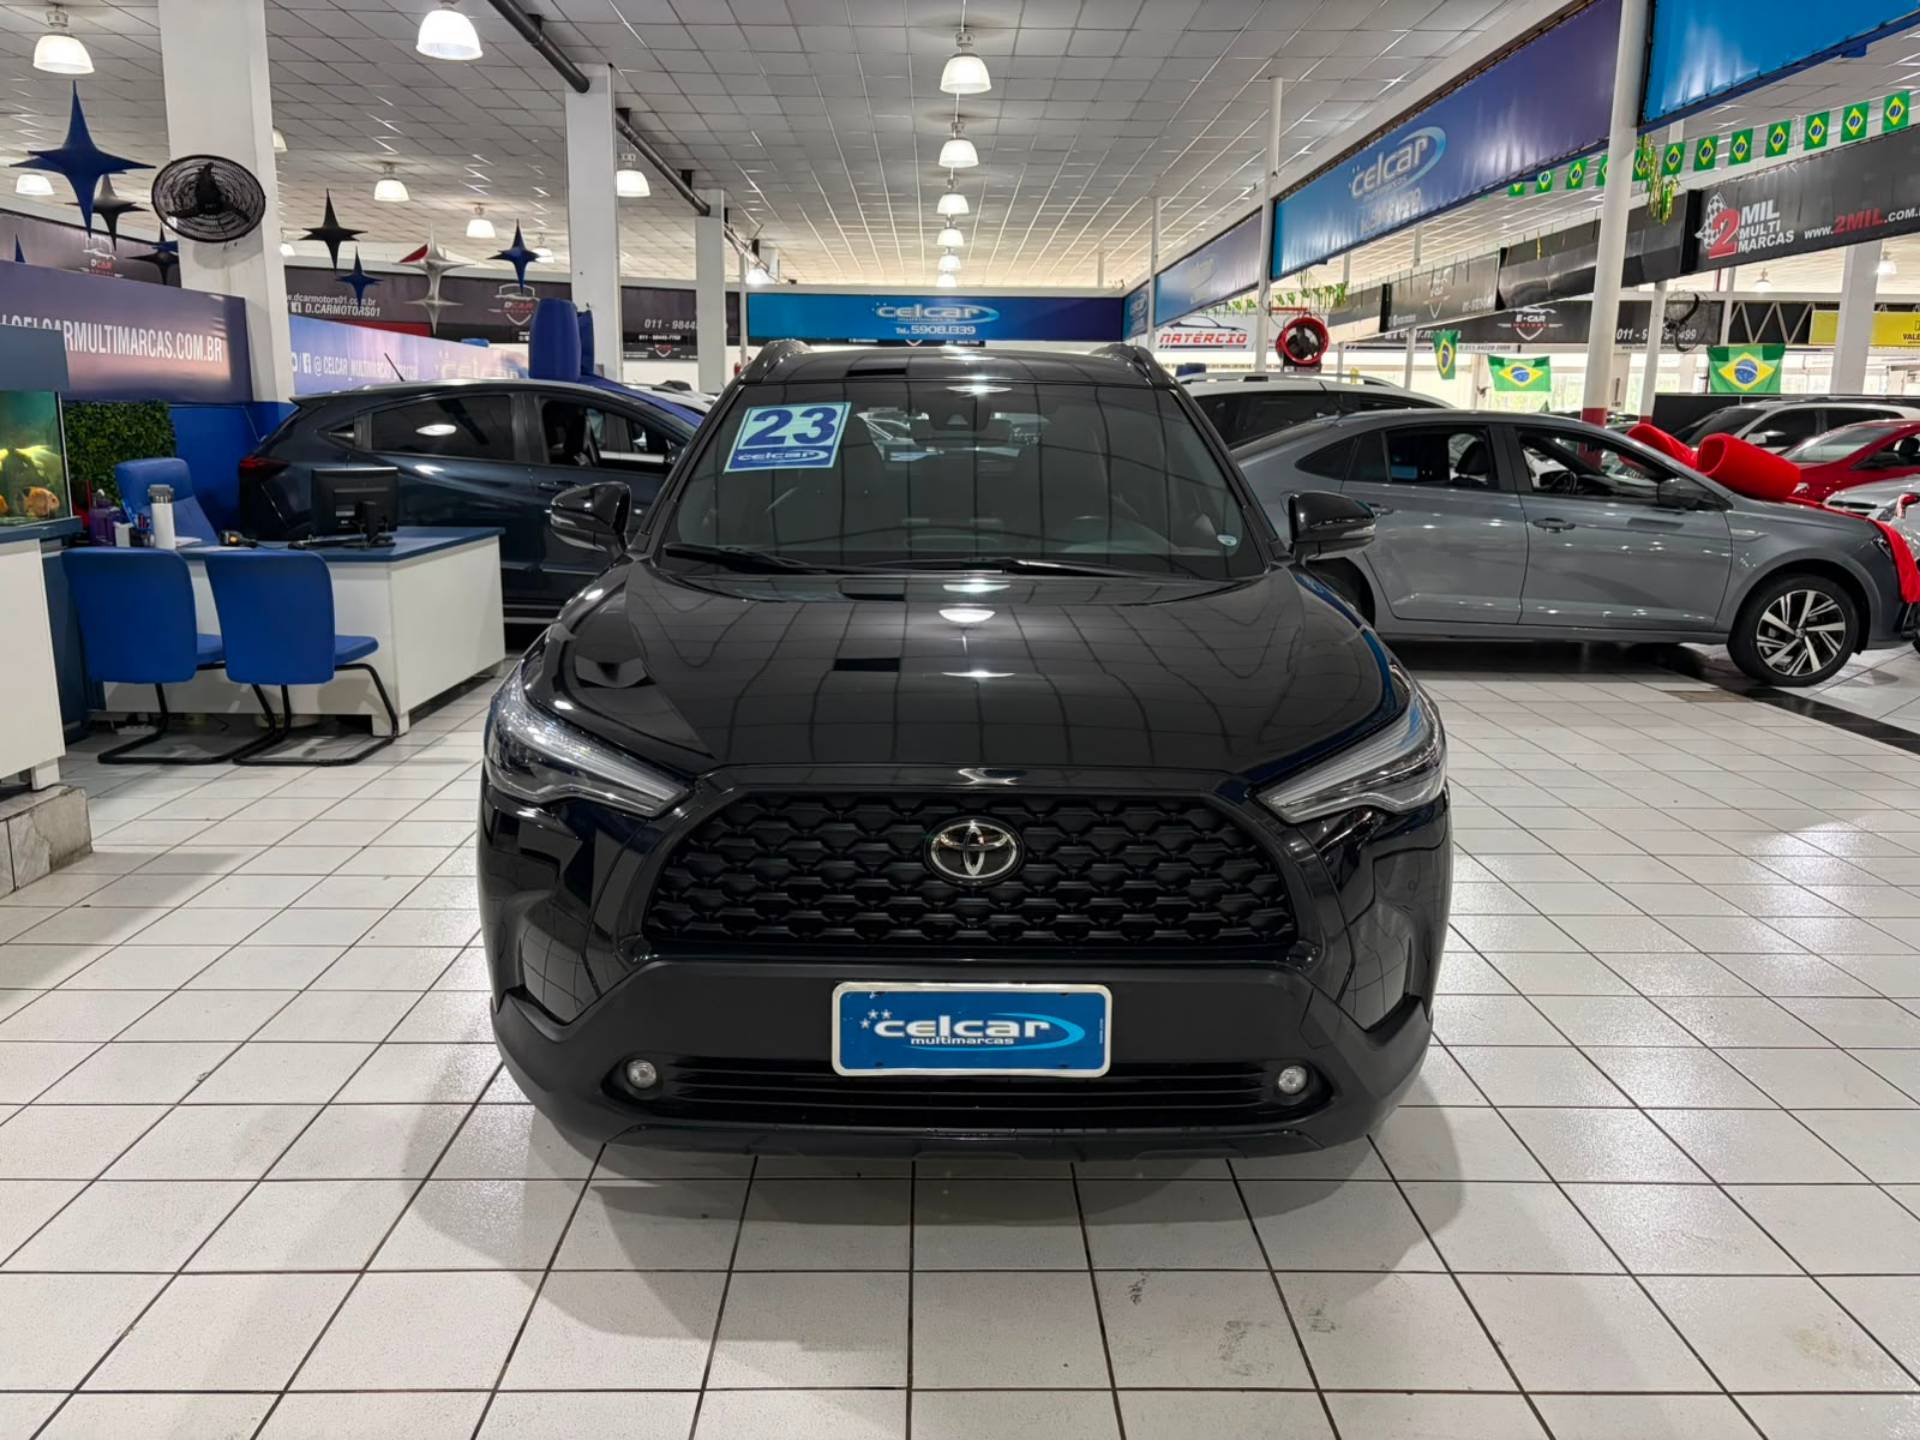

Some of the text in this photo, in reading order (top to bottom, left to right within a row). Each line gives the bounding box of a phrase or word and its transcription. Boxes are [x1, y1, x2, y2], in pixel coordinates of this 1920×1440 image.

[1351, 137, 1429, 198] celcar
[1708, 200, 1780, 259] 2 MIL
[1739, 220, 1781, 241] MULTI
[1738, 230, 1795, 255] MARCAS
[877, 304, 980, 319] celcar
[644, 319, 662, 329] 011
[672, 320, 698, 331] 9844
[1616, 328, 1633, 340] 011
[743, 407, 837, 446] 23
[874, 1015, 1050, 1037] celcar
[911, 1036, 1014, 1046] multimarcas
